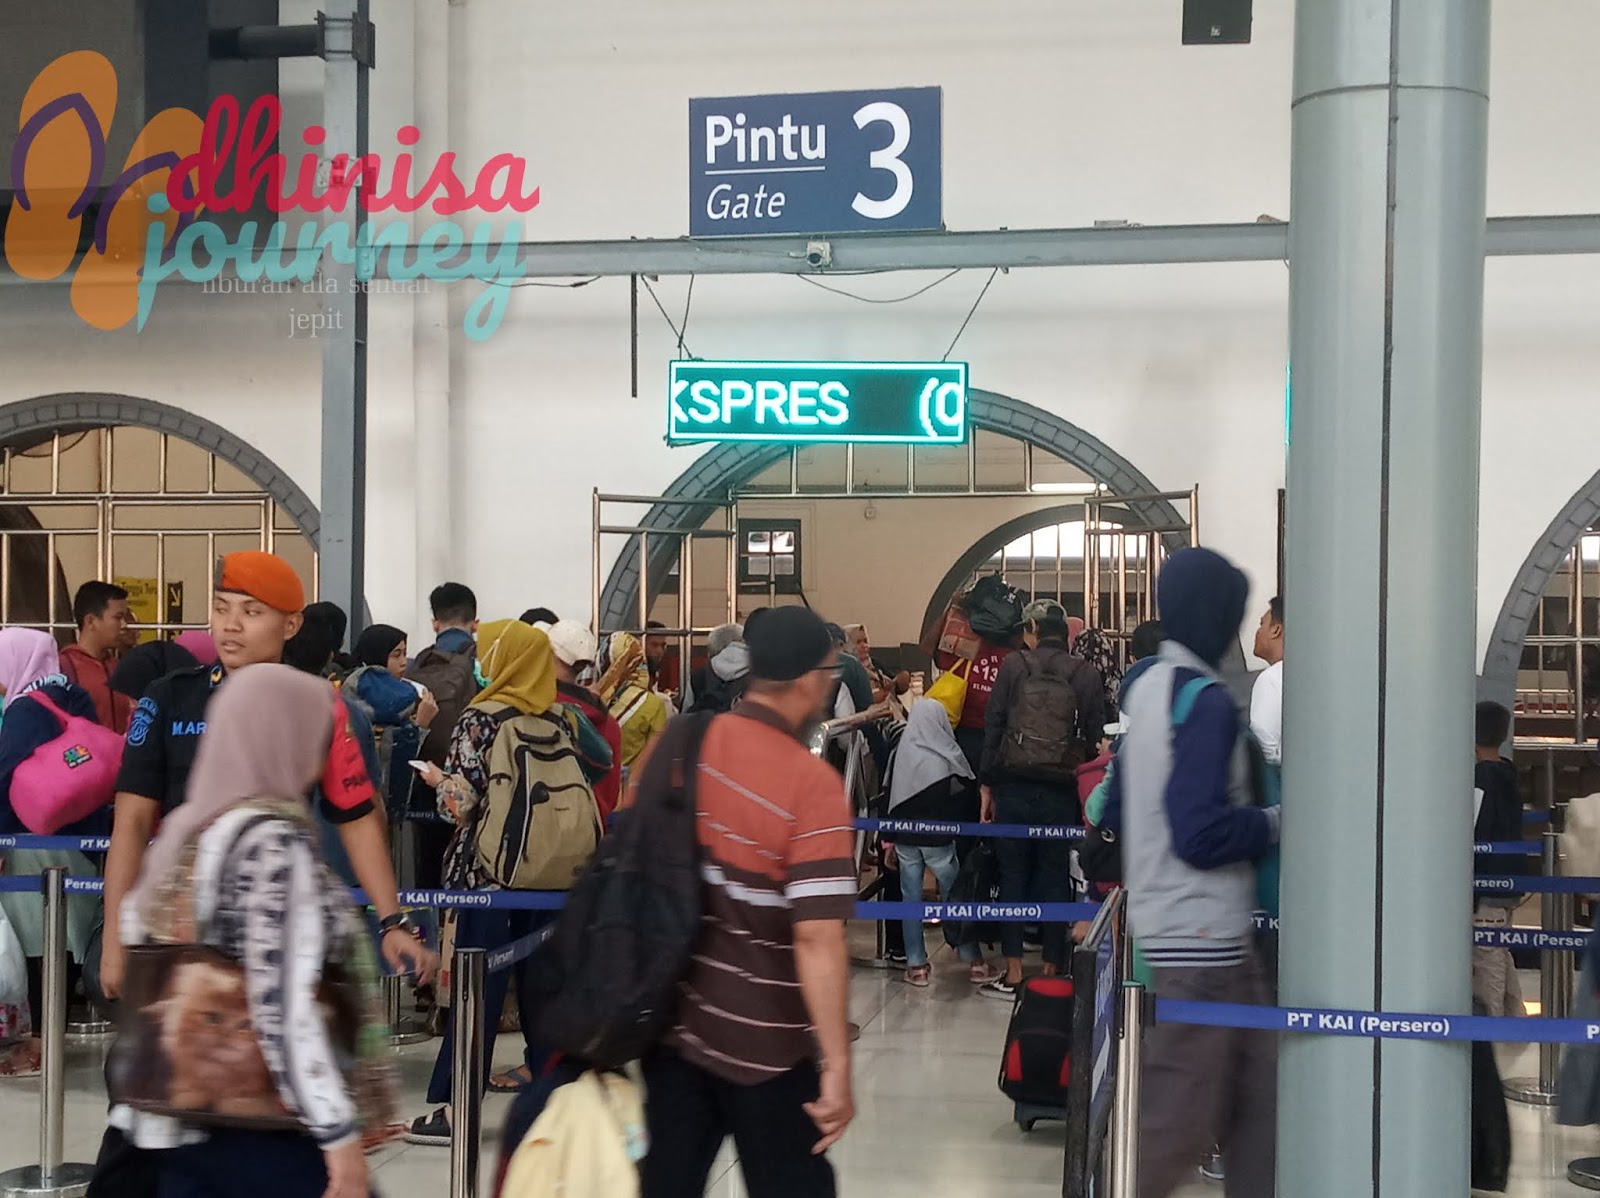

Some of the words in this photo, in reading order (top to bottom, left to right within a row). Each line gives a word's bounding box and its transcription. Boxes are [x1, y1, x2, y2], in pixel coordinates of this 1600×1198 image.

[705, 113, 826, 164] Pintu
[851, 101, 914, 219] 3
[706, 184, 786, 220] Gate
[879, 821, 894, 830] PT
[894, 821, 912, 831] KAI
[915, 823, 960, 833] (Persero)
[1029, 827, 1042, 837] PT
[1045, 828, 1063, 837] KAI
[80, 839, 95, 848] PT
[406, 892, 429, 903] KAI
[433, 893, 492, 906] (Persero)
[924, 905, 943, 917] PT
[946, 906, 972, 917] KAI
[977, 905, 1041, 919] (Persero)
[1474, 931, 1495, 943] PT
[1500, 931, 1528, 944] KAI
[1286, 1012, 1312, 1027] PT
[1318, 1014, 1353, 1030] KAI
[1360, 1017, 1450, 1036] (Persero)
